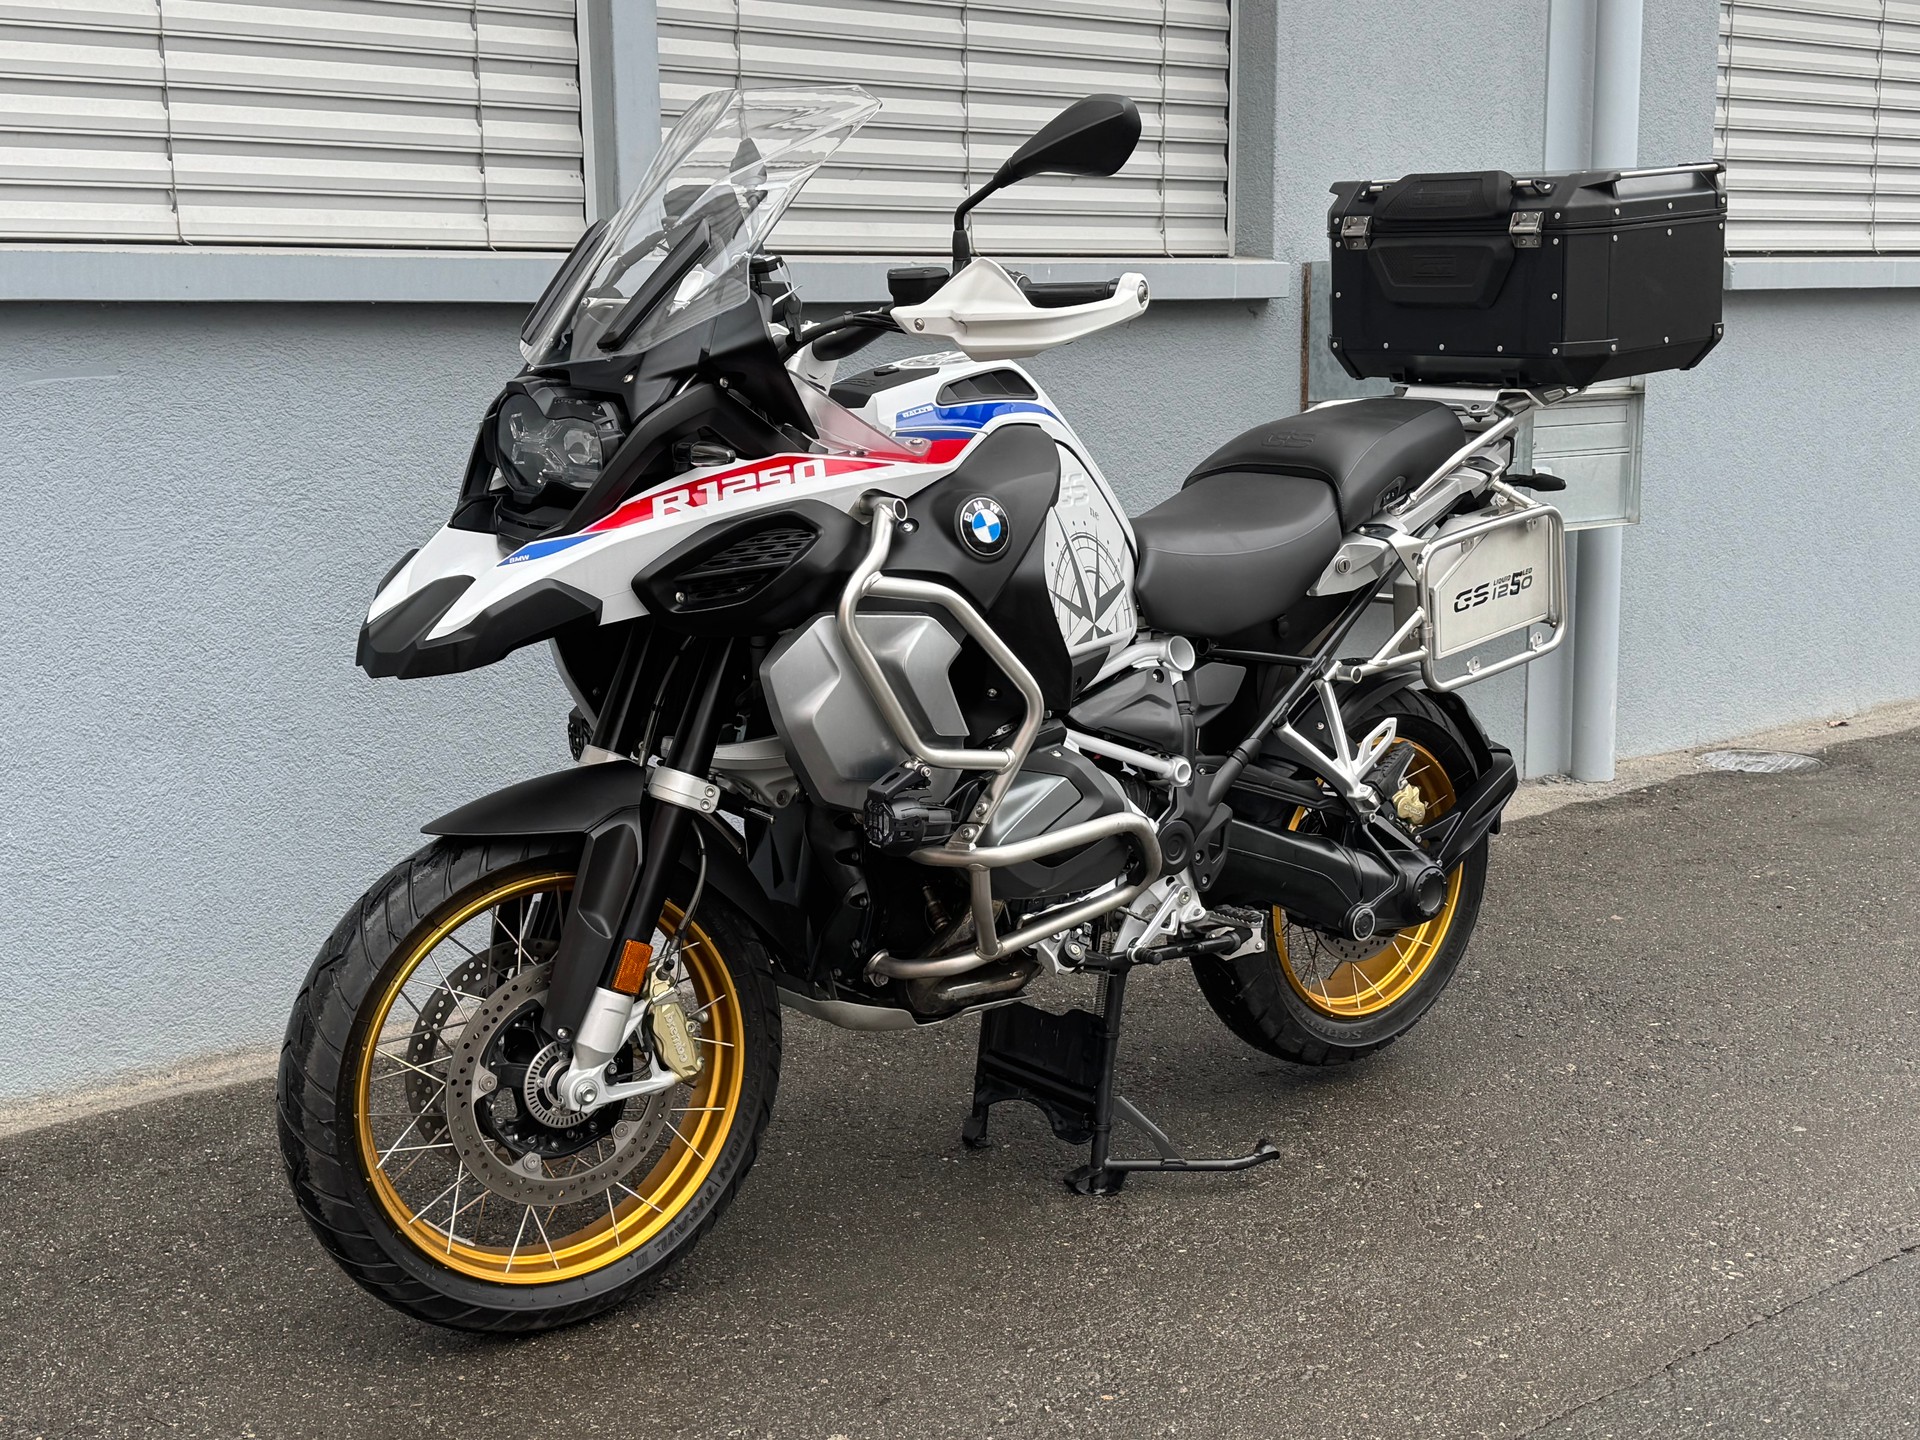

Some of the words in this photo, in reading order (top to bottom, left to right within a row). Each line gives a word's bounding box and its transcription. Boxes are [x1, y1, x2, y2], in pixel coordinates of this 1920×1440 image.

[963, 500, 1001, 523] BMW
[509, 554, 530, 564] BMW
[1493, 574, 1511, 586] LIQUID
[1453, 582, 1490, 613] GS
[1491, 572, 1533, 600] 1250
[663, 1011, 688, 1063] brembo
